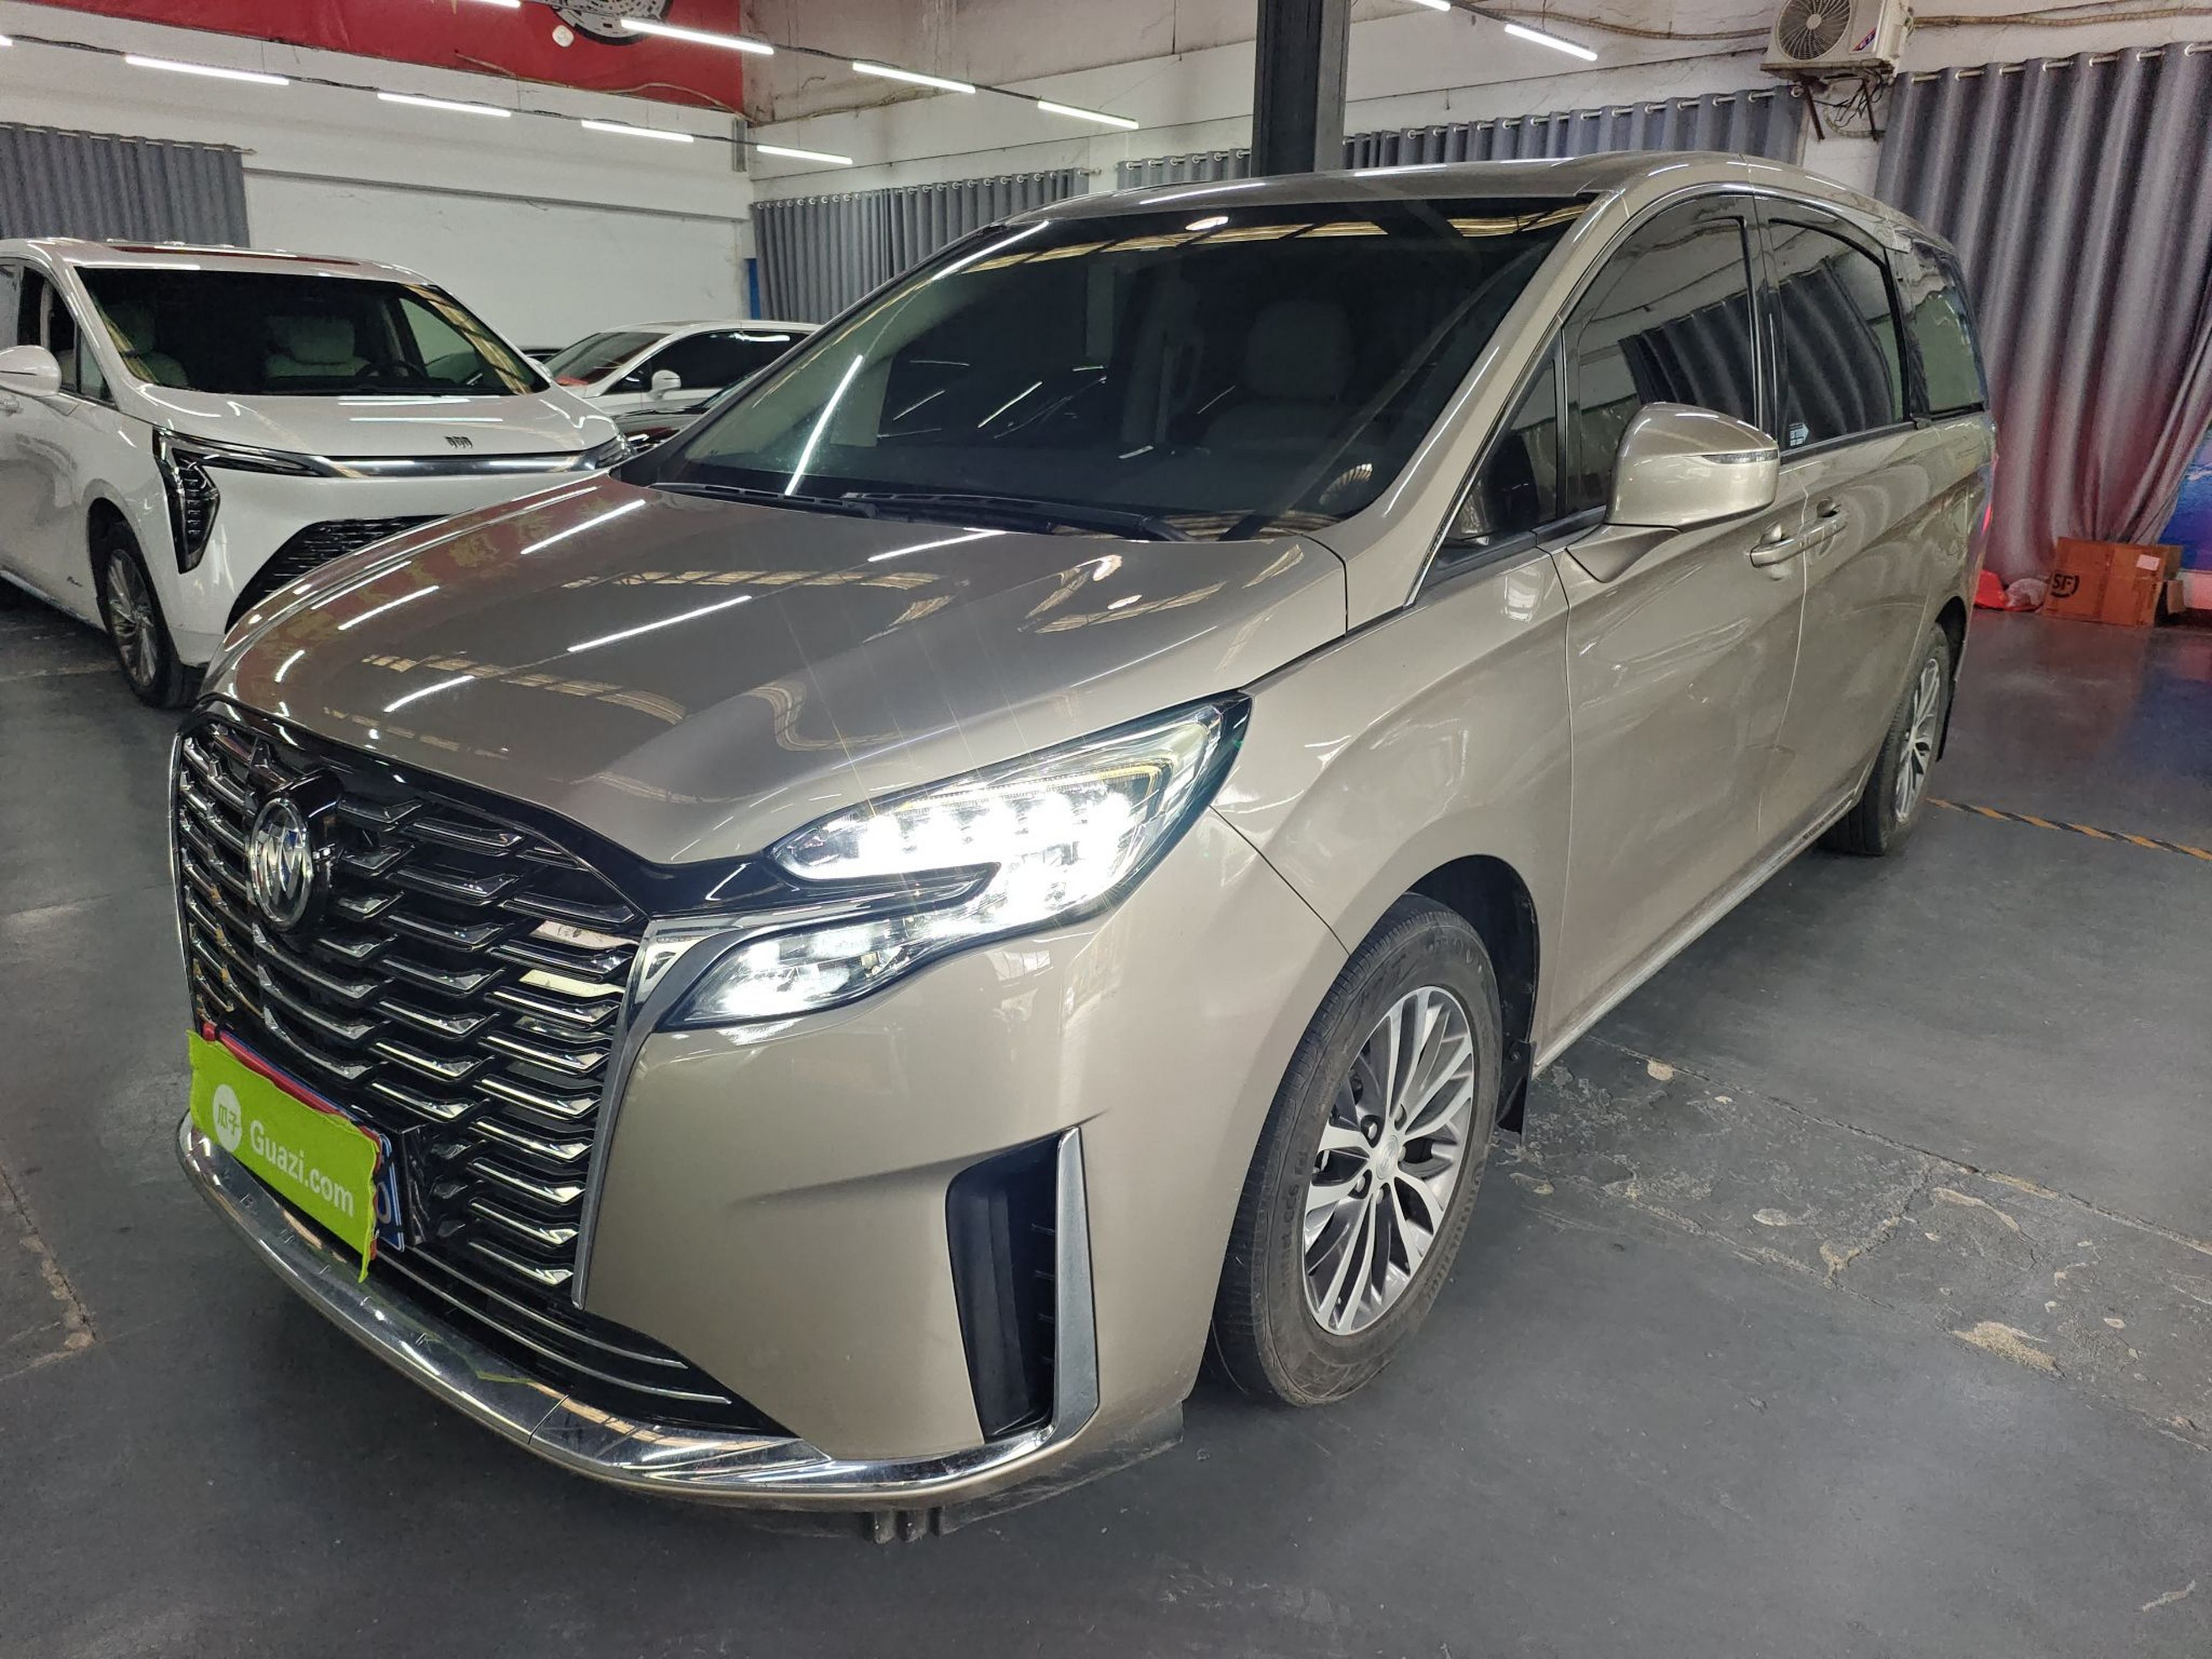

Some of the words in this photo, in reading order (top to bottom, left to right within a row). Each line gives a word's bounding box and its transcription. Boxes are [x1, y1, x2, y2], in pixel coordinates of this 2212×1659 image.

[2052, 573, 2074, 590] SF
[218, 1103, 240, 1136] 瓜子
[250, 1119, 354, 1218] Guazi.com
